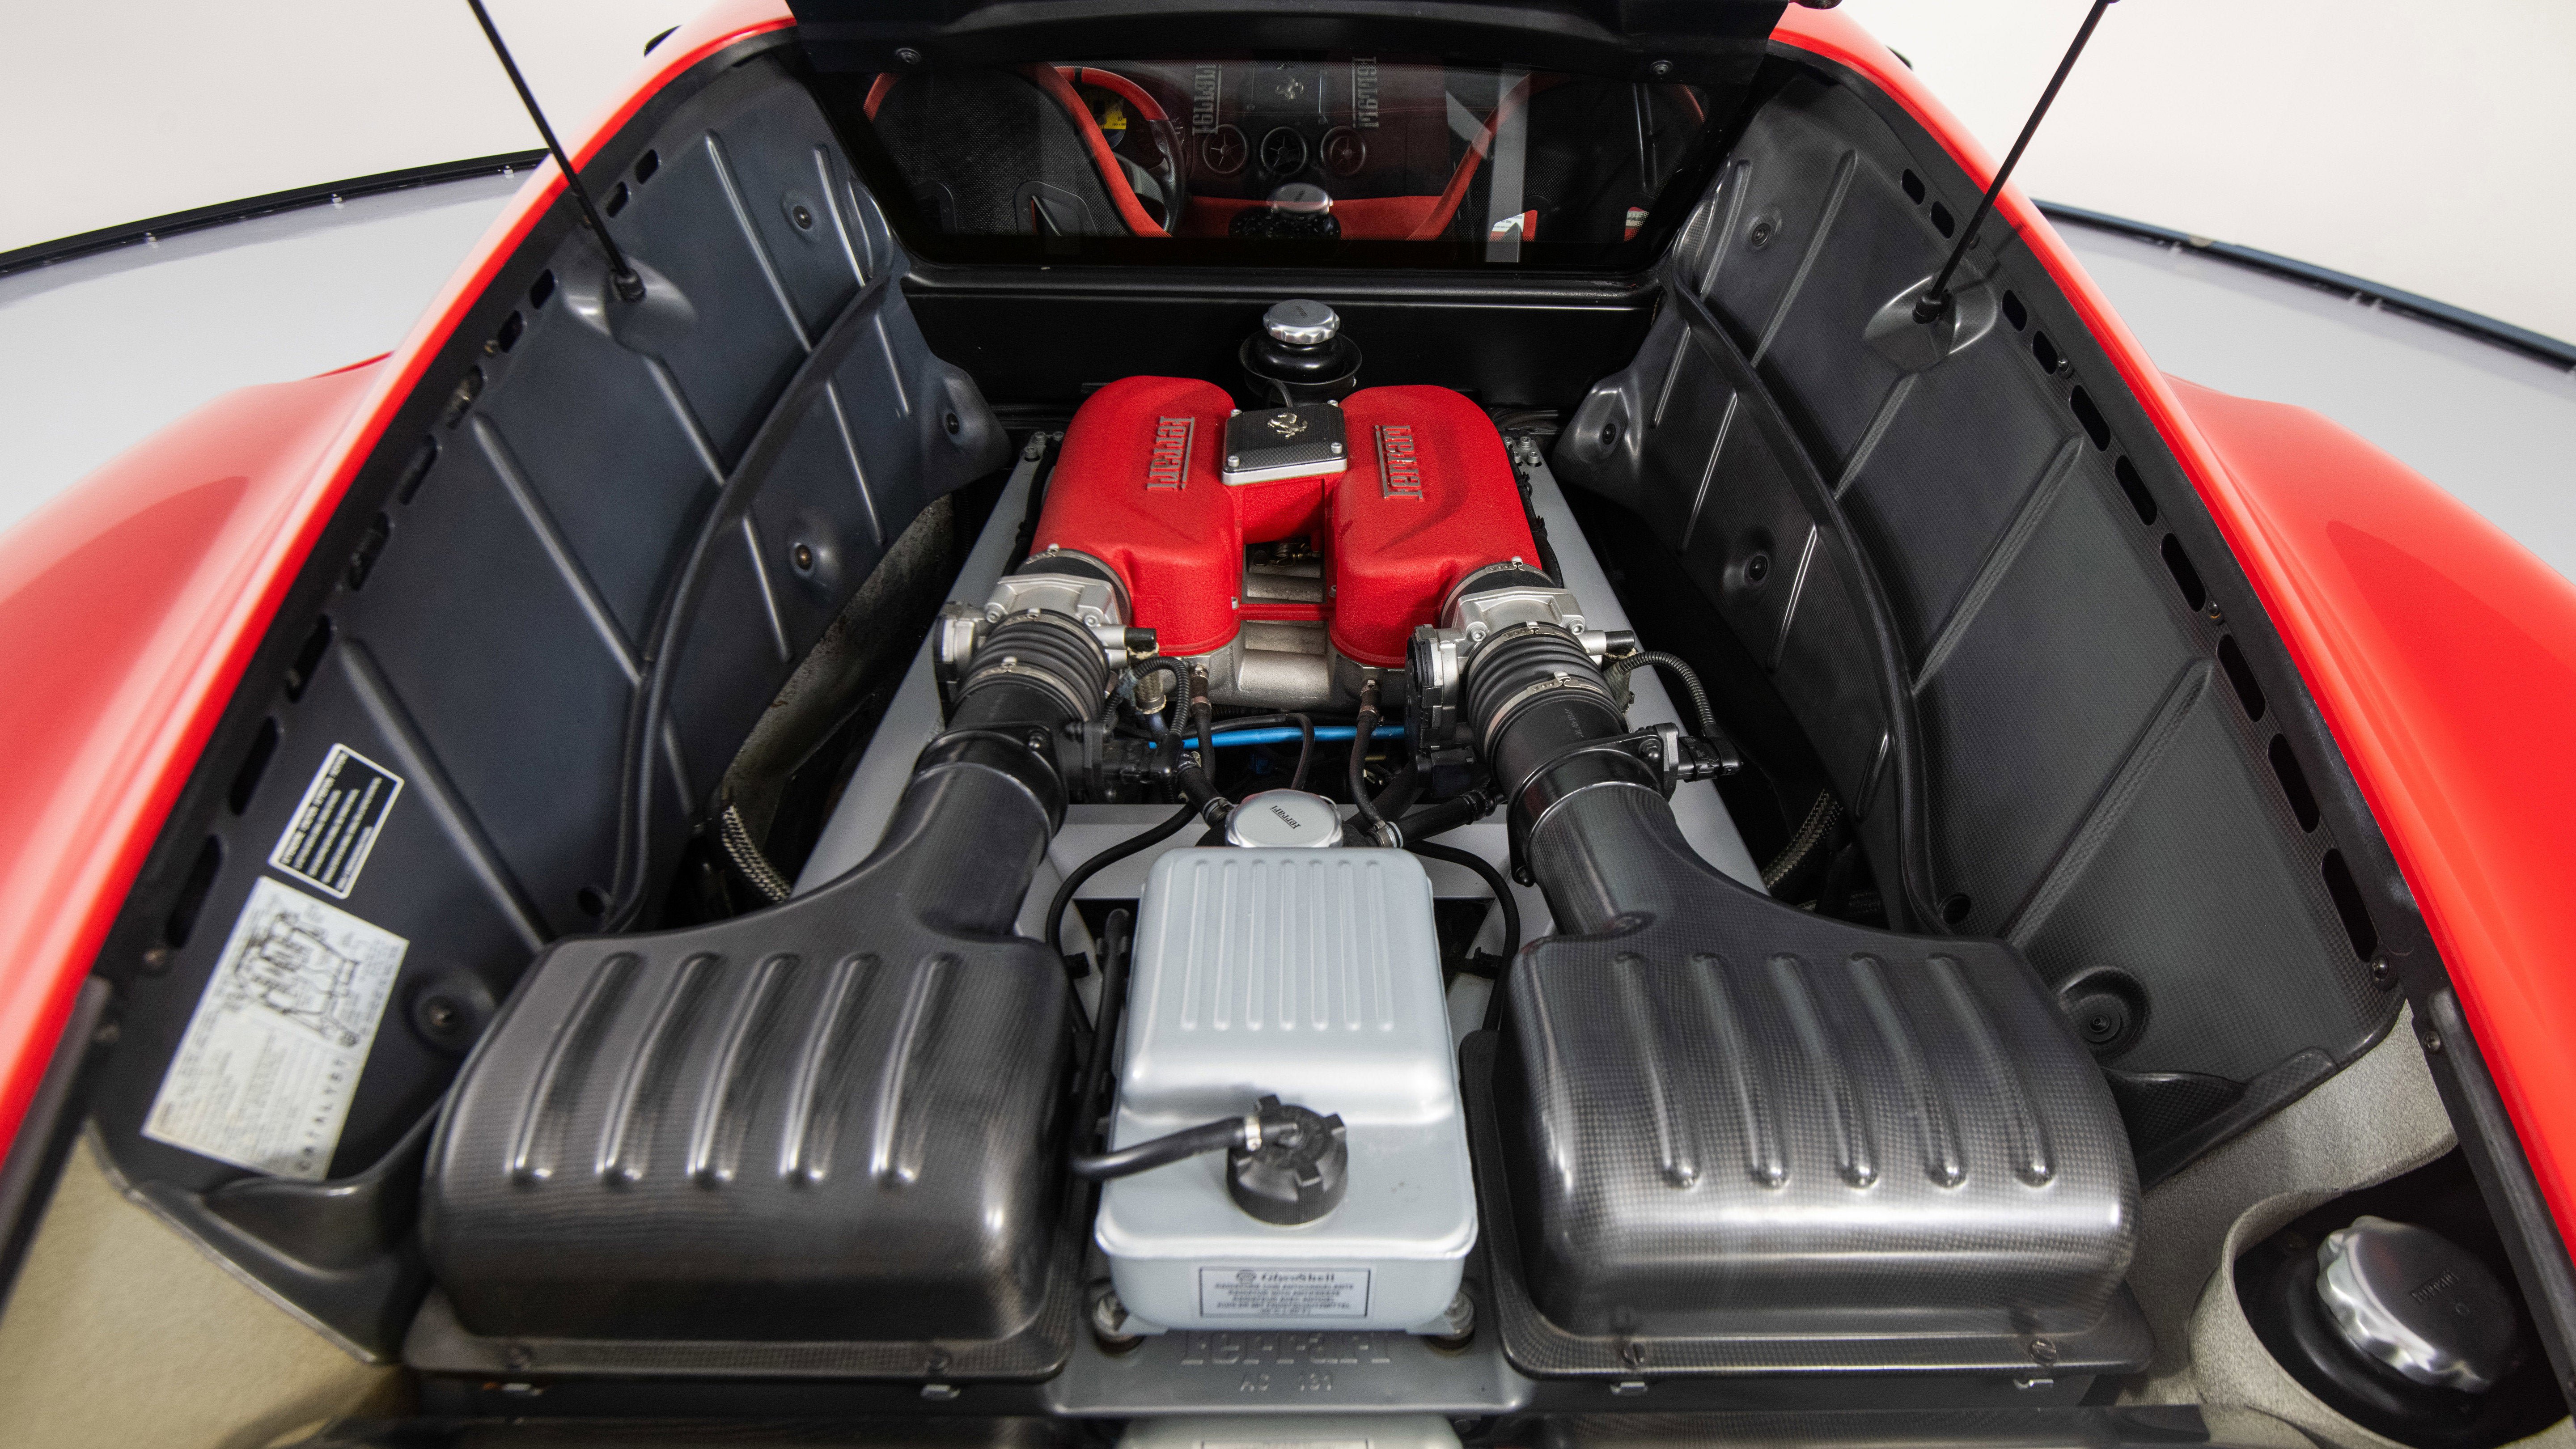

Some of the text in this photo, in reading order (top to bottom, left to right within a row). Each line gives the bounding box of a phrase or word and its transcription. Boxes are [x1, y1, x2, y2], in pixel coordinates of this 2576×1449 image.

[1147, 416, 1195, 491] Ferrari
[1375, 424, 1425, 501] Ferrari
[1270, 805, 1301, 830] Ferrari
